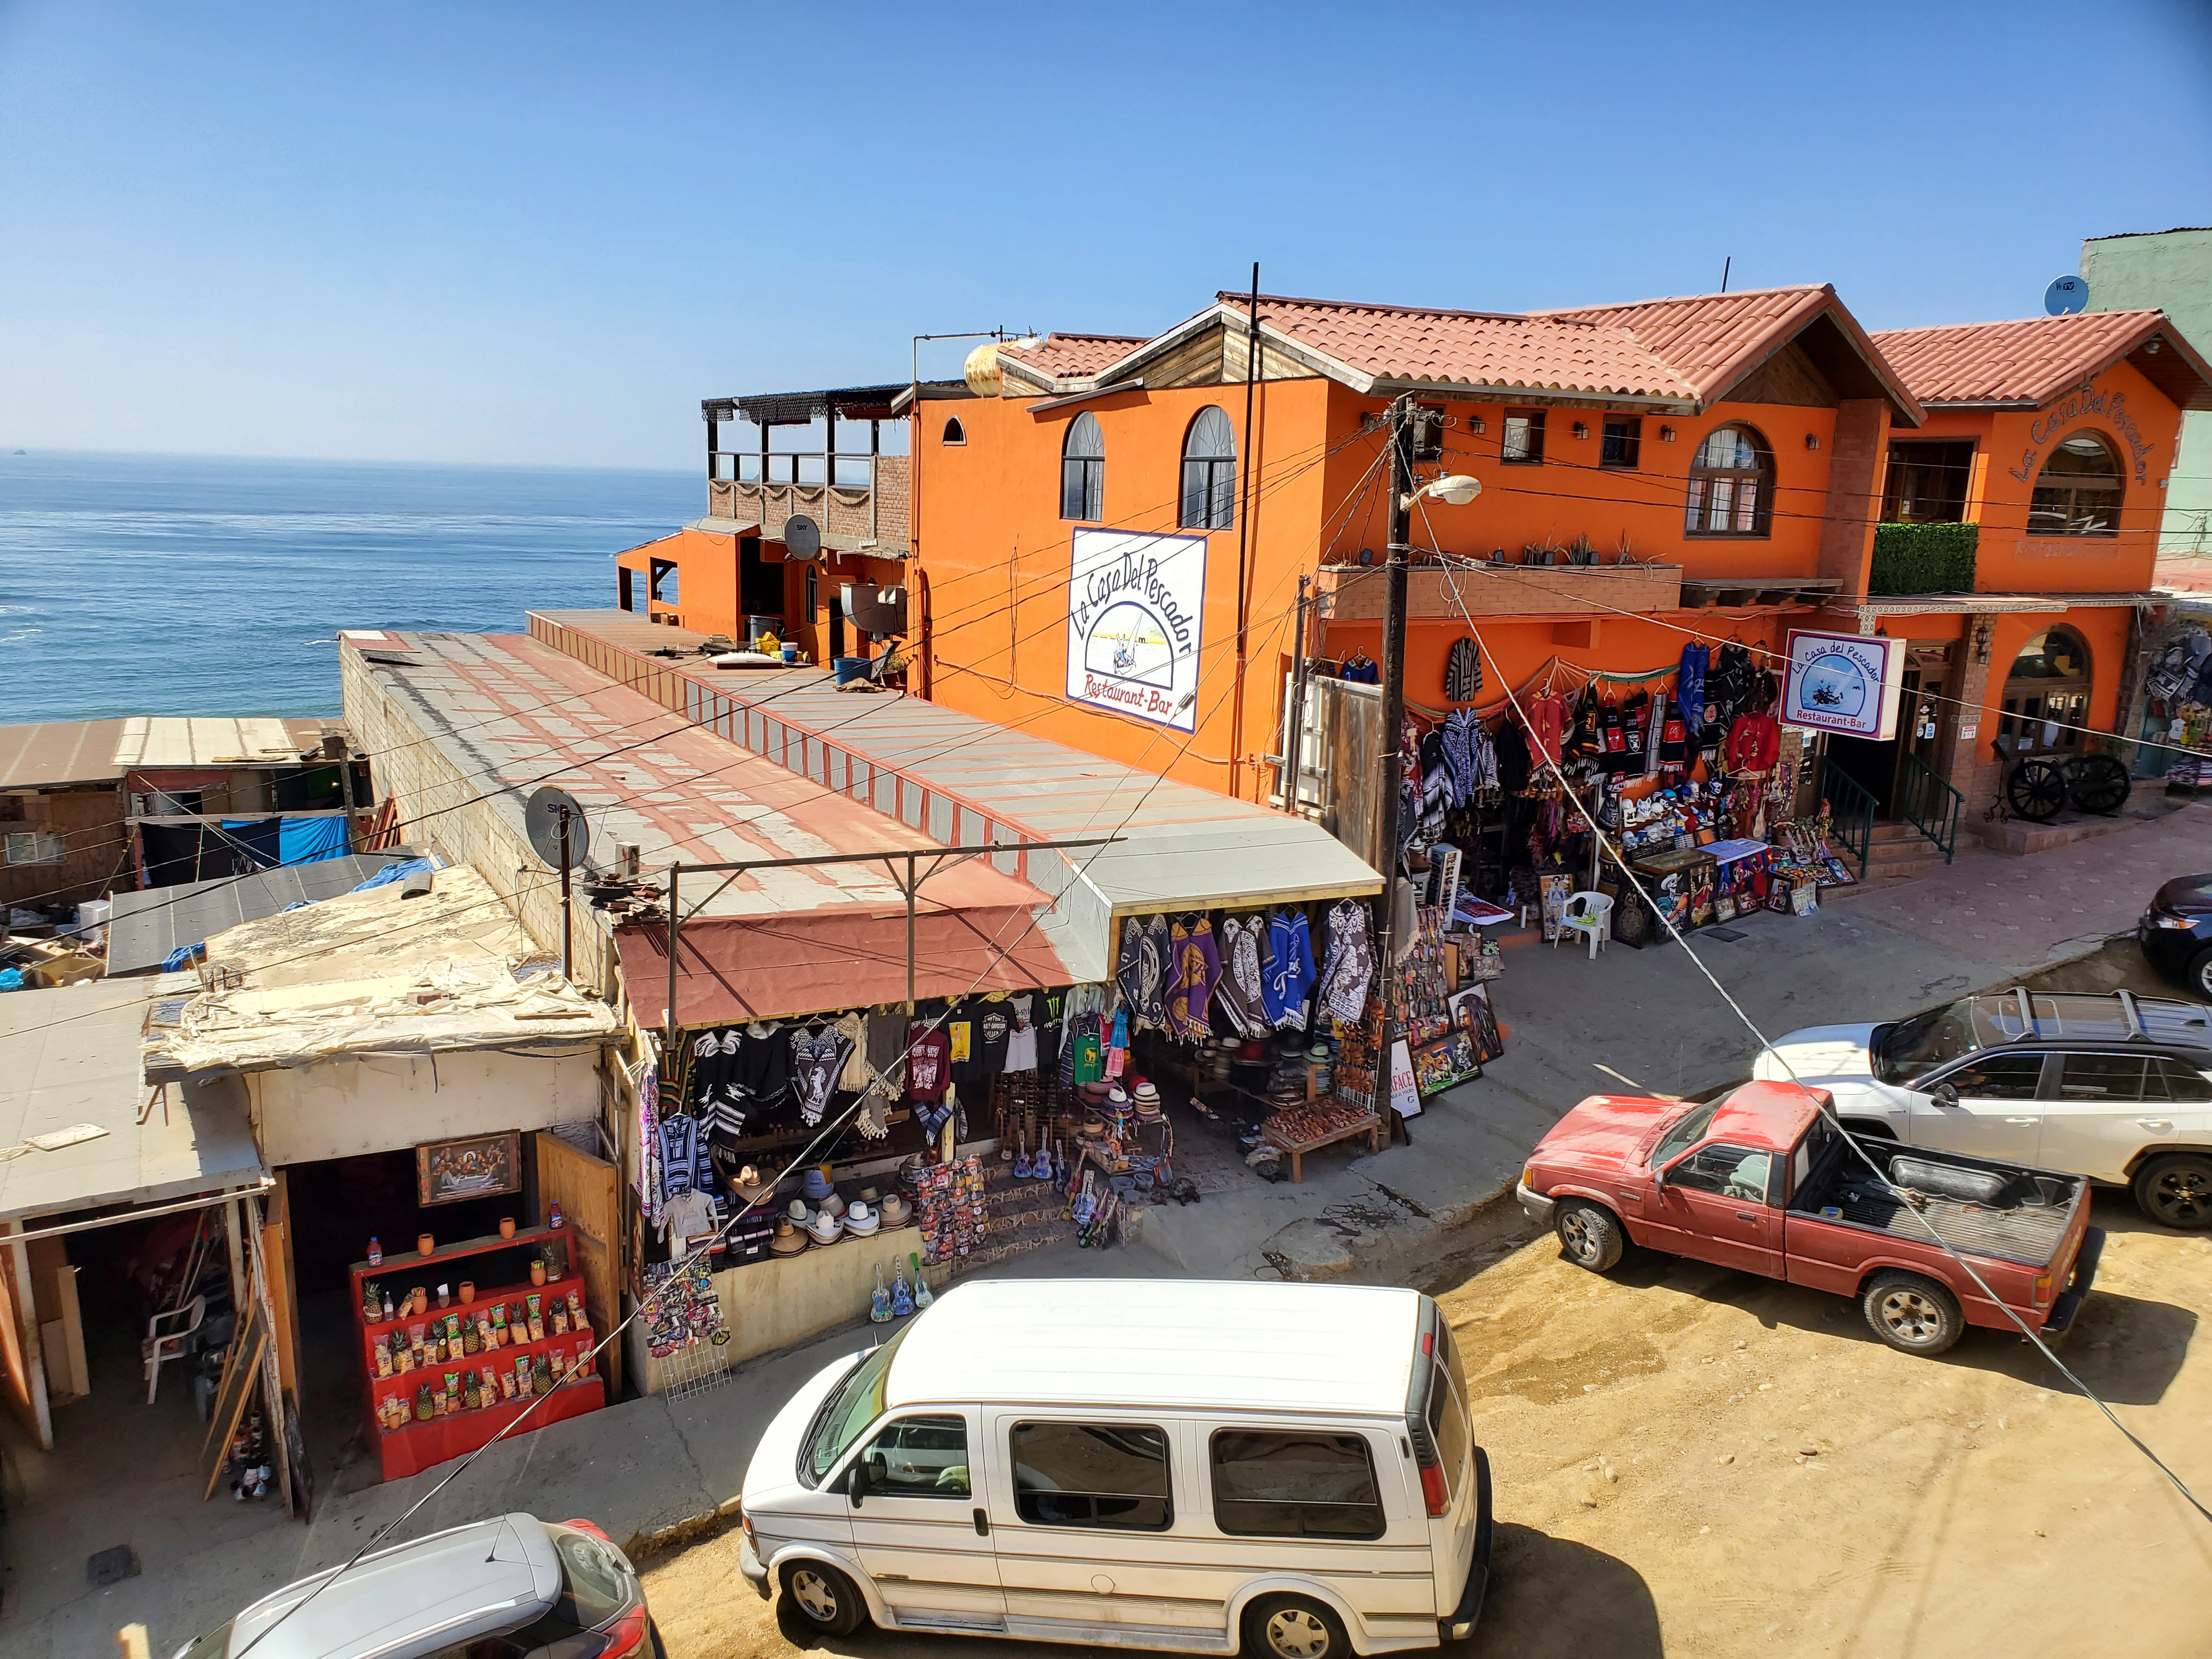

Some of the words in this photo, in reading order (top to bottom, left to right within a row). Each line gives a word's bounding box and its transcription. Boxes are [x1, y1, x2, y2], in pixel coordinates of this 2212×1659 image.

[2008, 449, 2036, 483] La
[2032, 398, 2078, 444] Casa
[2080, 385, 2108, 414] Del
[2107, 392, 2155, 486] Pescador
[1071, 600, 1090, 641] La
[1087, 569, 1121, 607] Casa
[1122, 552, 1145, 591] Del
[1144, 558, 1194, 654] Pescador
[1792, 662, 1804, 675] La
[1805, 645, 1827, 662] Casa
[1830, 641, 1844, 653] del
[1847, 646, 1881, 682] Pescador
[1084, 674, 1173, 715] Restaurant-Bar
[1797, 709, 1867, 729] Restaurant-Bar
